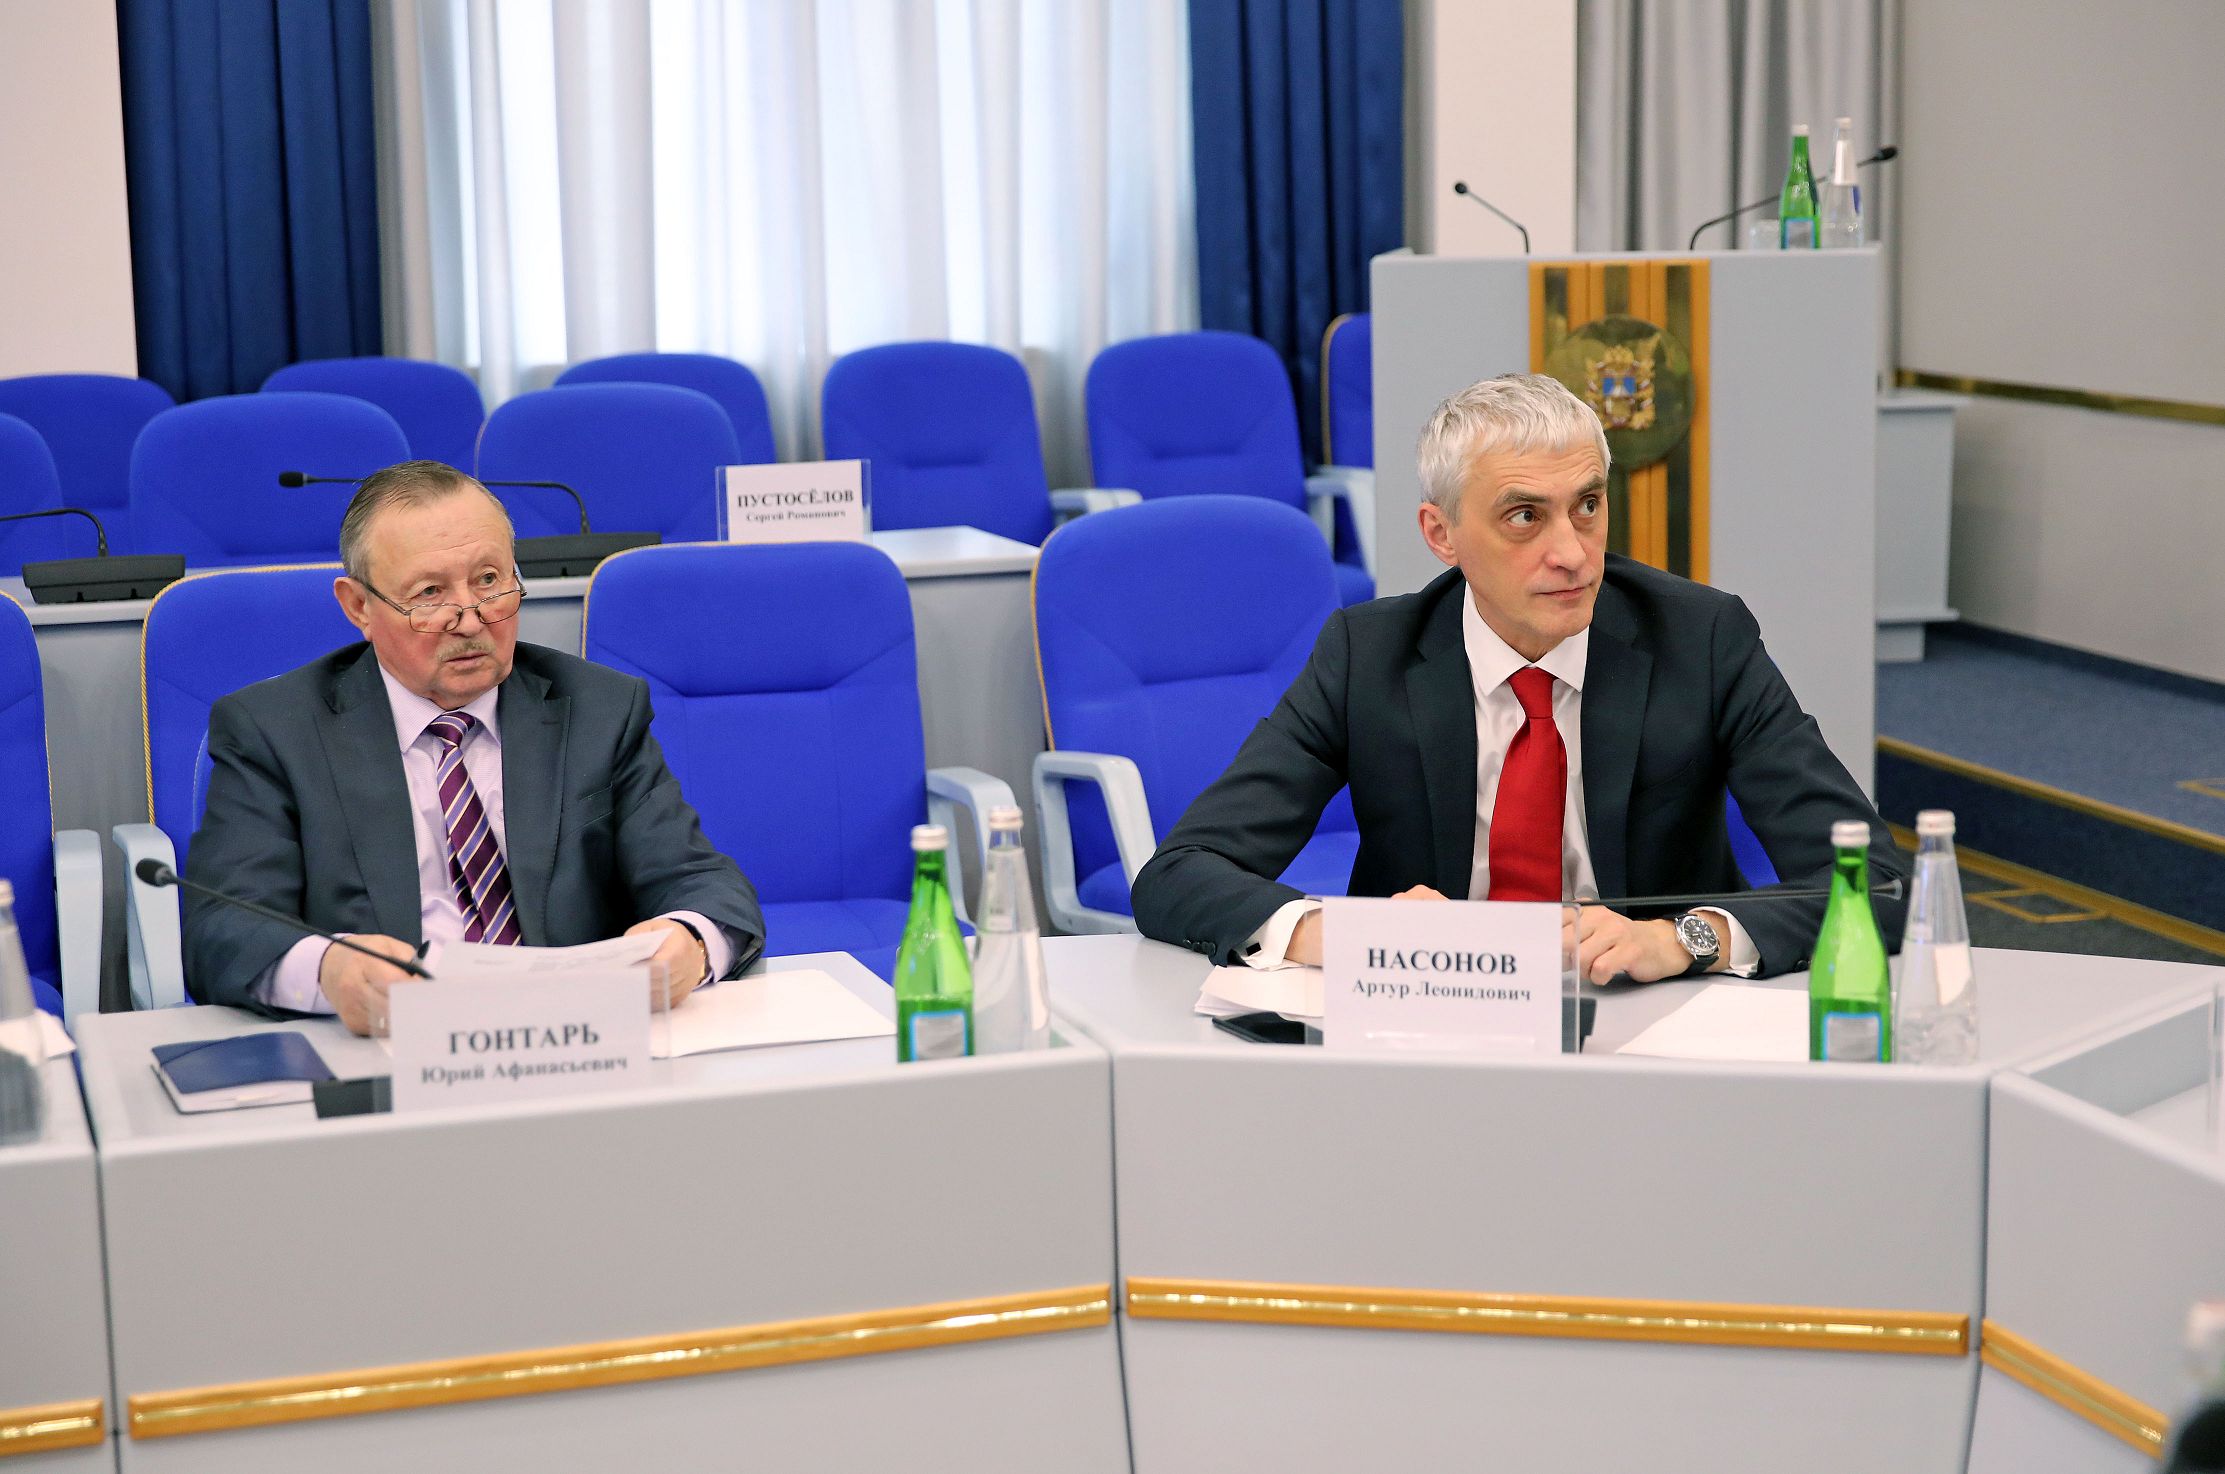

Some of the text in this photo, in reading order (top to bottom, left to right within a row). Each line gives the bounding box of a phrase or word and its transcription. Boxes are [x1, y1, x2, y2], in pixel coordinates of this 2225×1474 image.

[737, 488, 854, 508] ПУСТОСЁЛОВ
[746, 510, 846, 523] Сергей Романович
[1367, 948, 1517, 975] НАСОНОВ
[1352, 979, 1531, 1001] Артур Леонидович
[449, 1023, 600, 1055] ГОНТАРЬ
[421, 1056, 628, 1086] Юрий Афанасьевич
